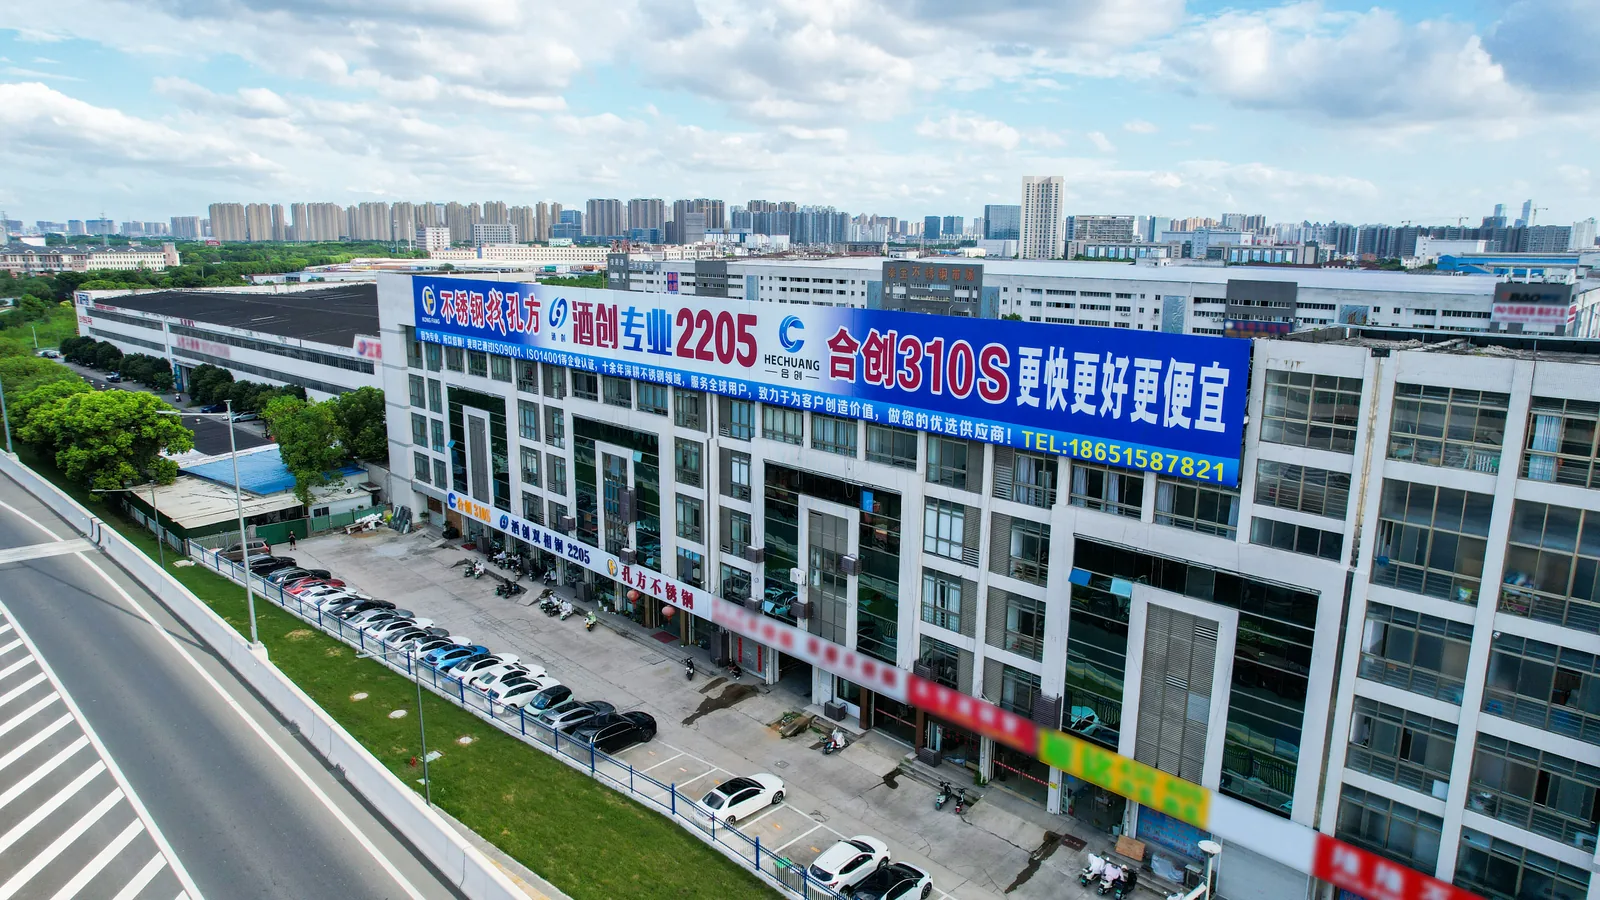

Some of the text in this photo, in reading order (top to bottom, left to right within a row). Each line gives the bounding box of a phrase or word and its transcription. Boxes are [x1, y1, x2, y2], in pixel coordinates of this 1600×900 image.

[764, 353, 820, 372] HECHUANG
[567, 543, 590, 565] 2205
[621, 564, 694, 610] 孔方不锈钢
